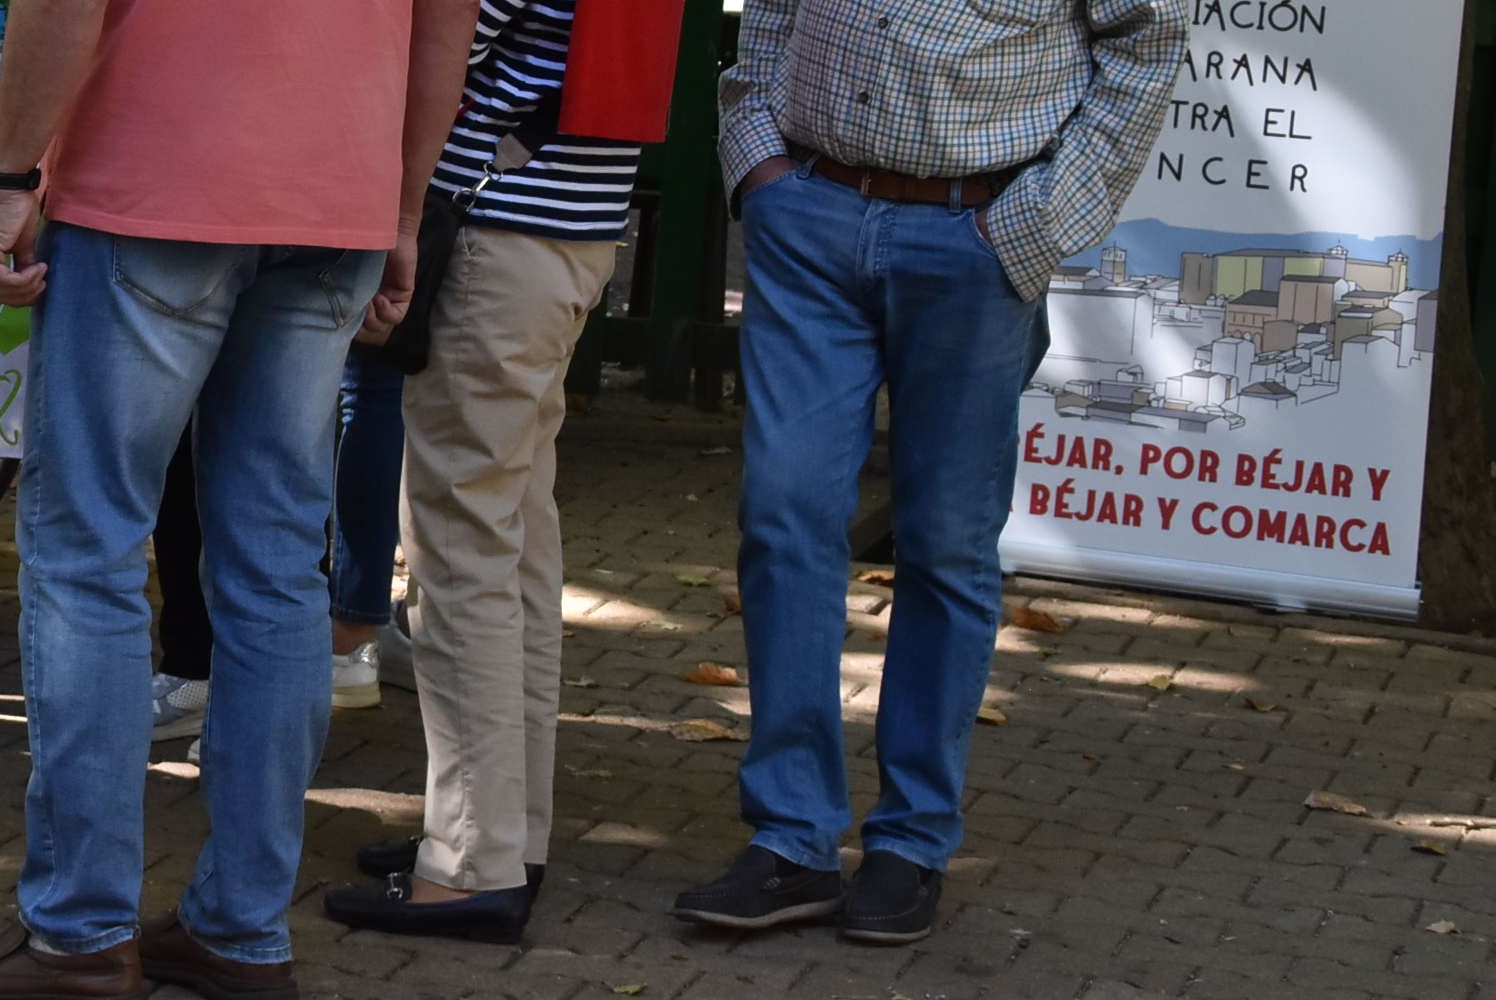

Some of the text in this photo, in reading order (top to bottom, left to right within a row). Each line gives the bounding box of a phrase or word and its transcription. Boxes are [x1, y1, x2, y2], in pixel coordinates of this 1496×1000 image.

[1183, 48, 1318, 91] ARANA
[1170, 99, 1313, 140] TRA EL
[1157, 152, 1309, 193] NCER
[1016, 422, 1391, 502] ÉJAR, POR BÉJAR Y
[1028, 478, 1392, 557] BÉJAR Y COMARCA
